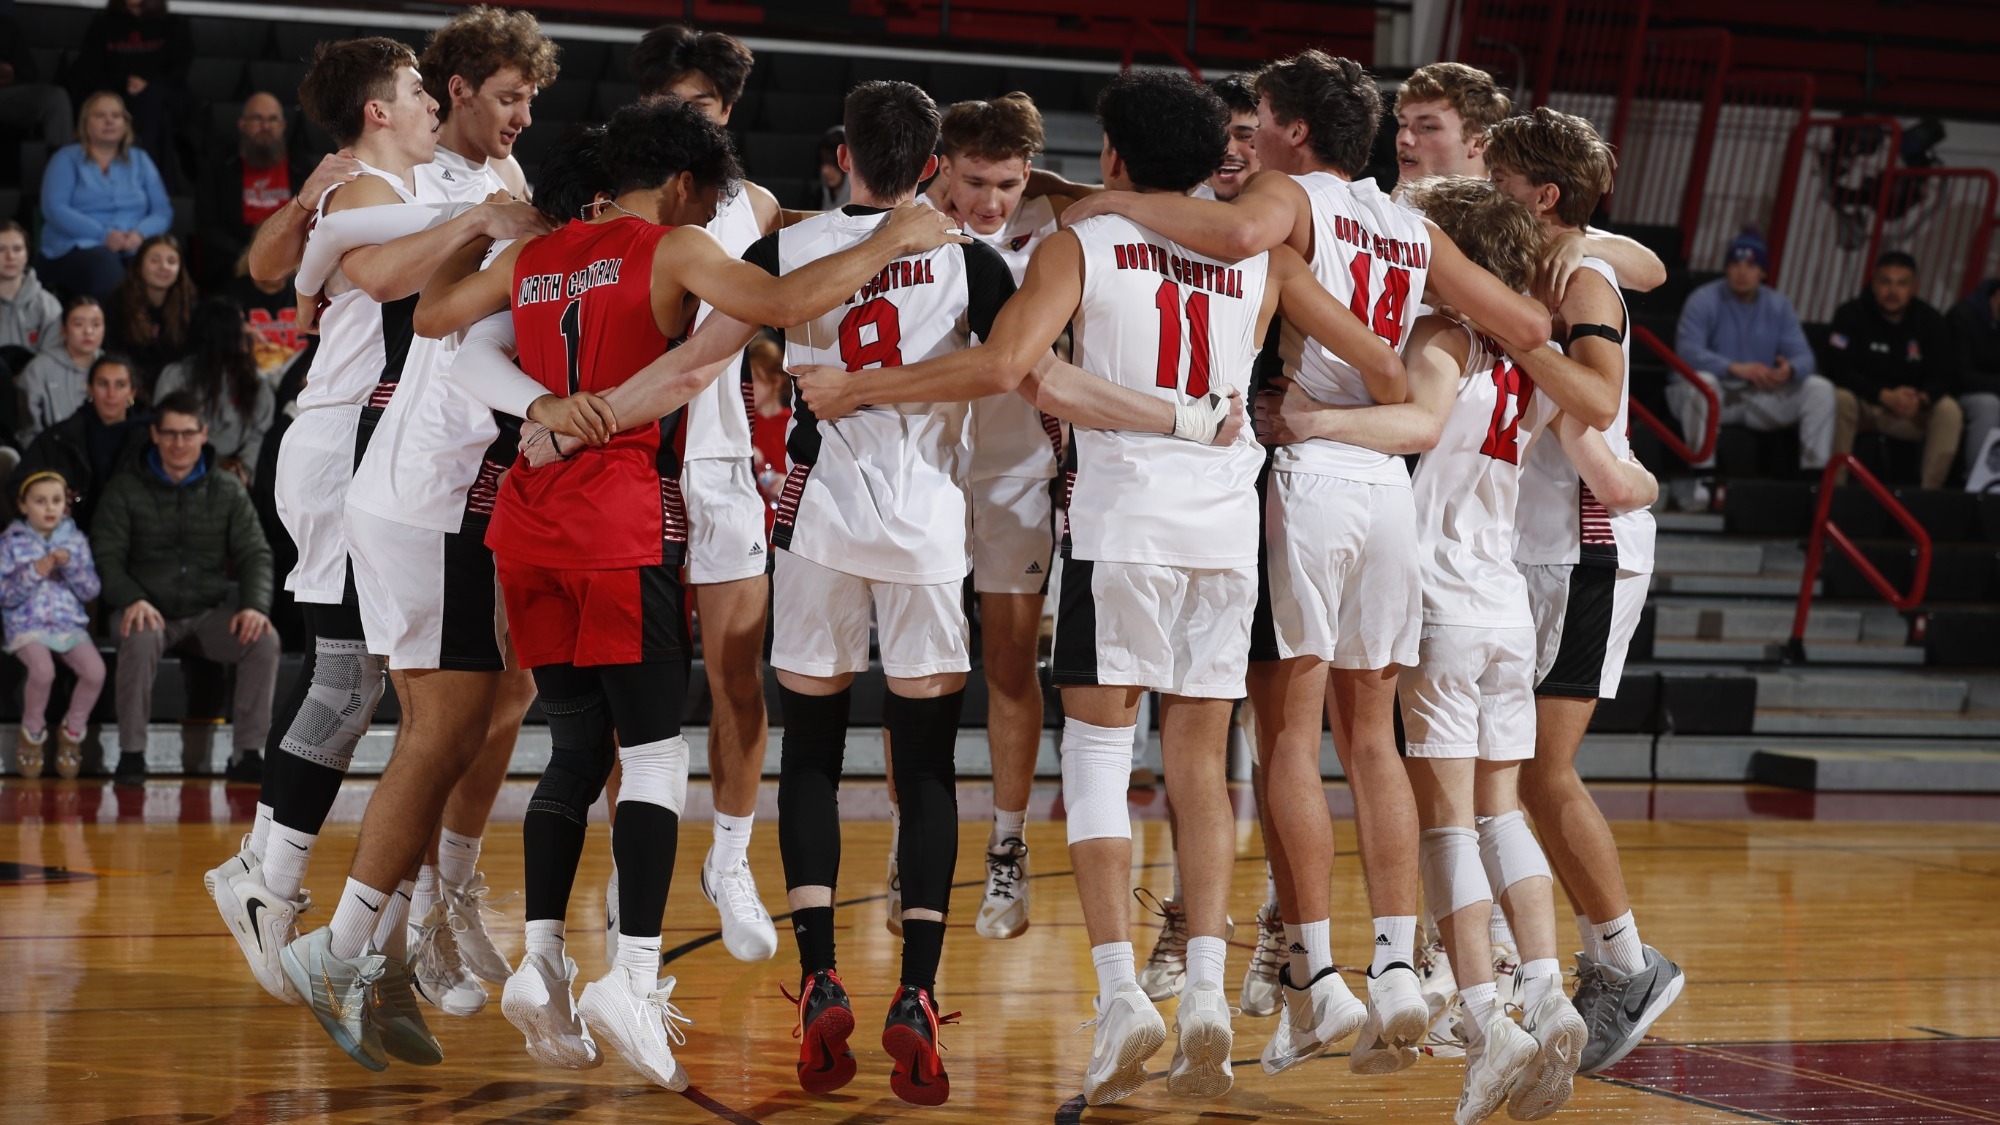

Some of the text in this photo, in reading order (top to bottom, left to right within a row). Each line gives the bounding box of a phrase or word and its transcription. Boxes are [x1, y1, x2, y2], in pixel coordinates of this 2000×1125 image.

[518, 258, 623, 308] NORTH CENTRAL
[1114, 242, 1243, 299] NORTH CENTRAL
[1349, 250, 1411, 350] 14
[560, 297, 582, 397] 1
[838, 296, 904, 373] 8
[1155, 278, 1210, 399] 11
[1479, 360, 1535, 466] 12
[776, 463, 810, 527] CARDINALS
